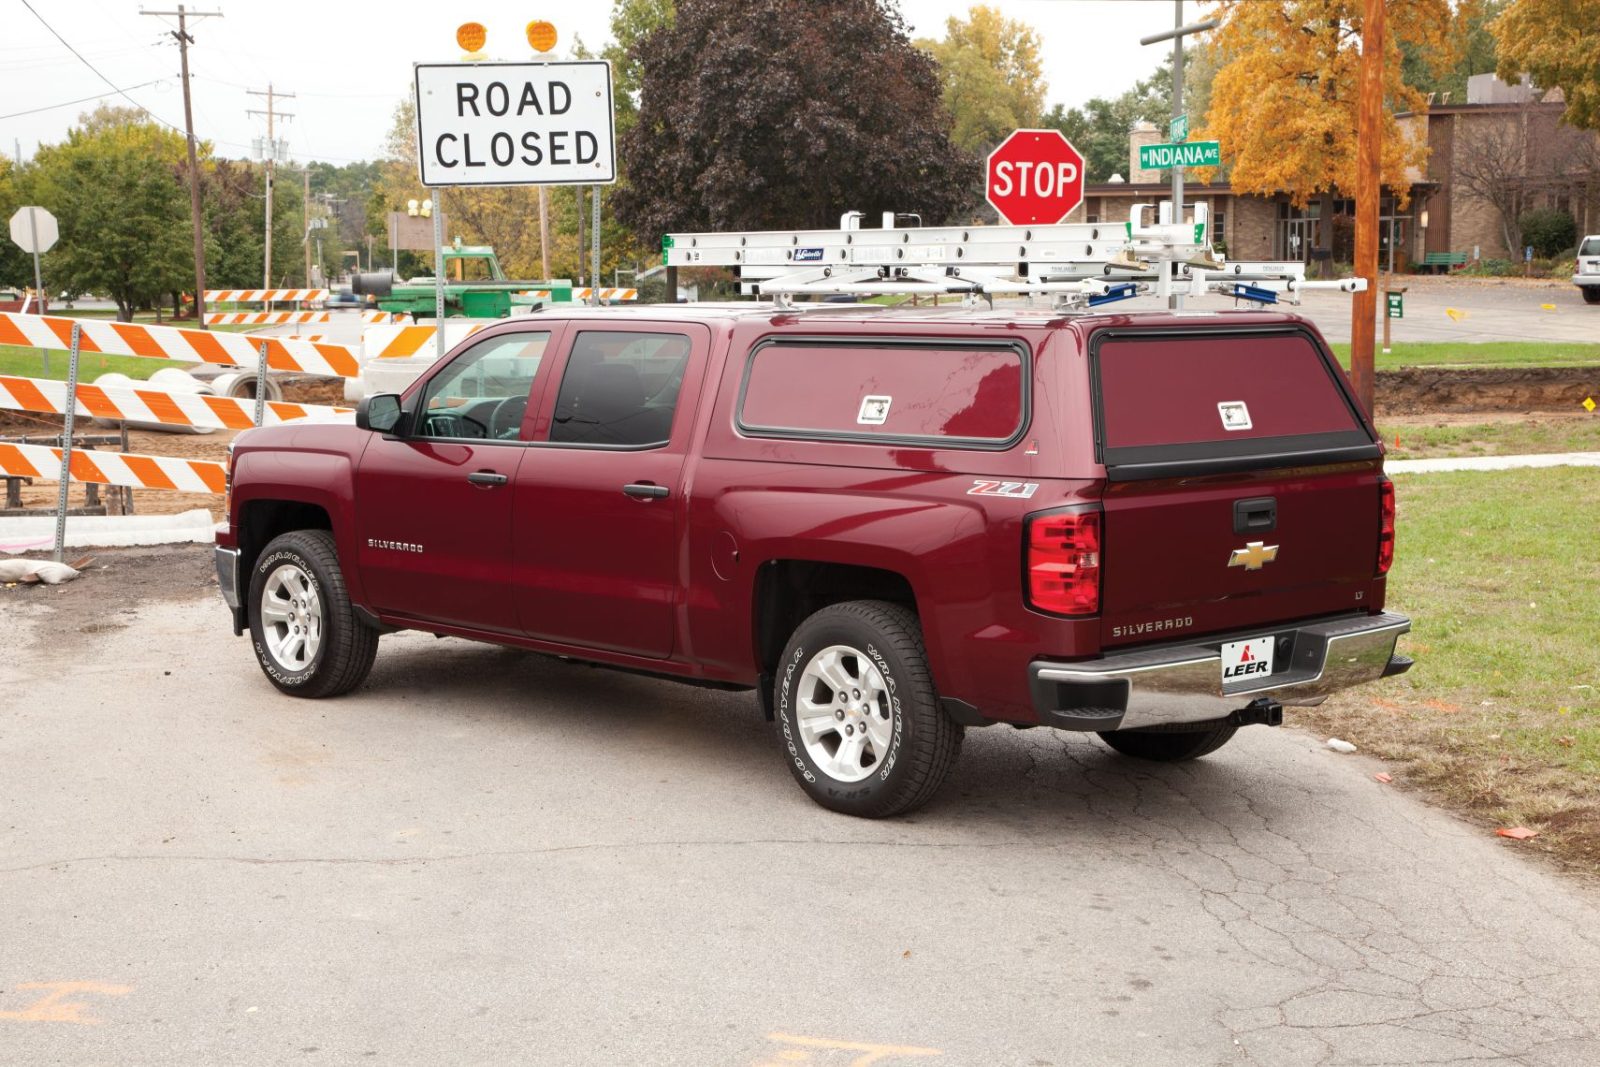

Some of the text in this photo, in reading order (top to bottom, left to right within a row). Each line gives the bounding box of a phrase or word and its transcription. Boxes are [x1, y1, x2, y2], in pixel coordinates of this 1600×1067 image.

[457, 82, 571, 116] ROAD
[436, 131, 598, 168] CLOSED
[1142, 146, 1218, 166] W INDIANA AVE
[993, 160, 1077, 197] STOP
[966, 480, 1039, 498] Z71
[367, 538, 423, 553] SILVERADO
[260, 552, 320, 591] WRANGLER
[1112, 616, 1193, 638] SILVERADO
[1223, 661, 1268, 679] LEER
[780, 647, 815, 783] GOODYEAR
[867, 643, 902, 781] WRANGLER
